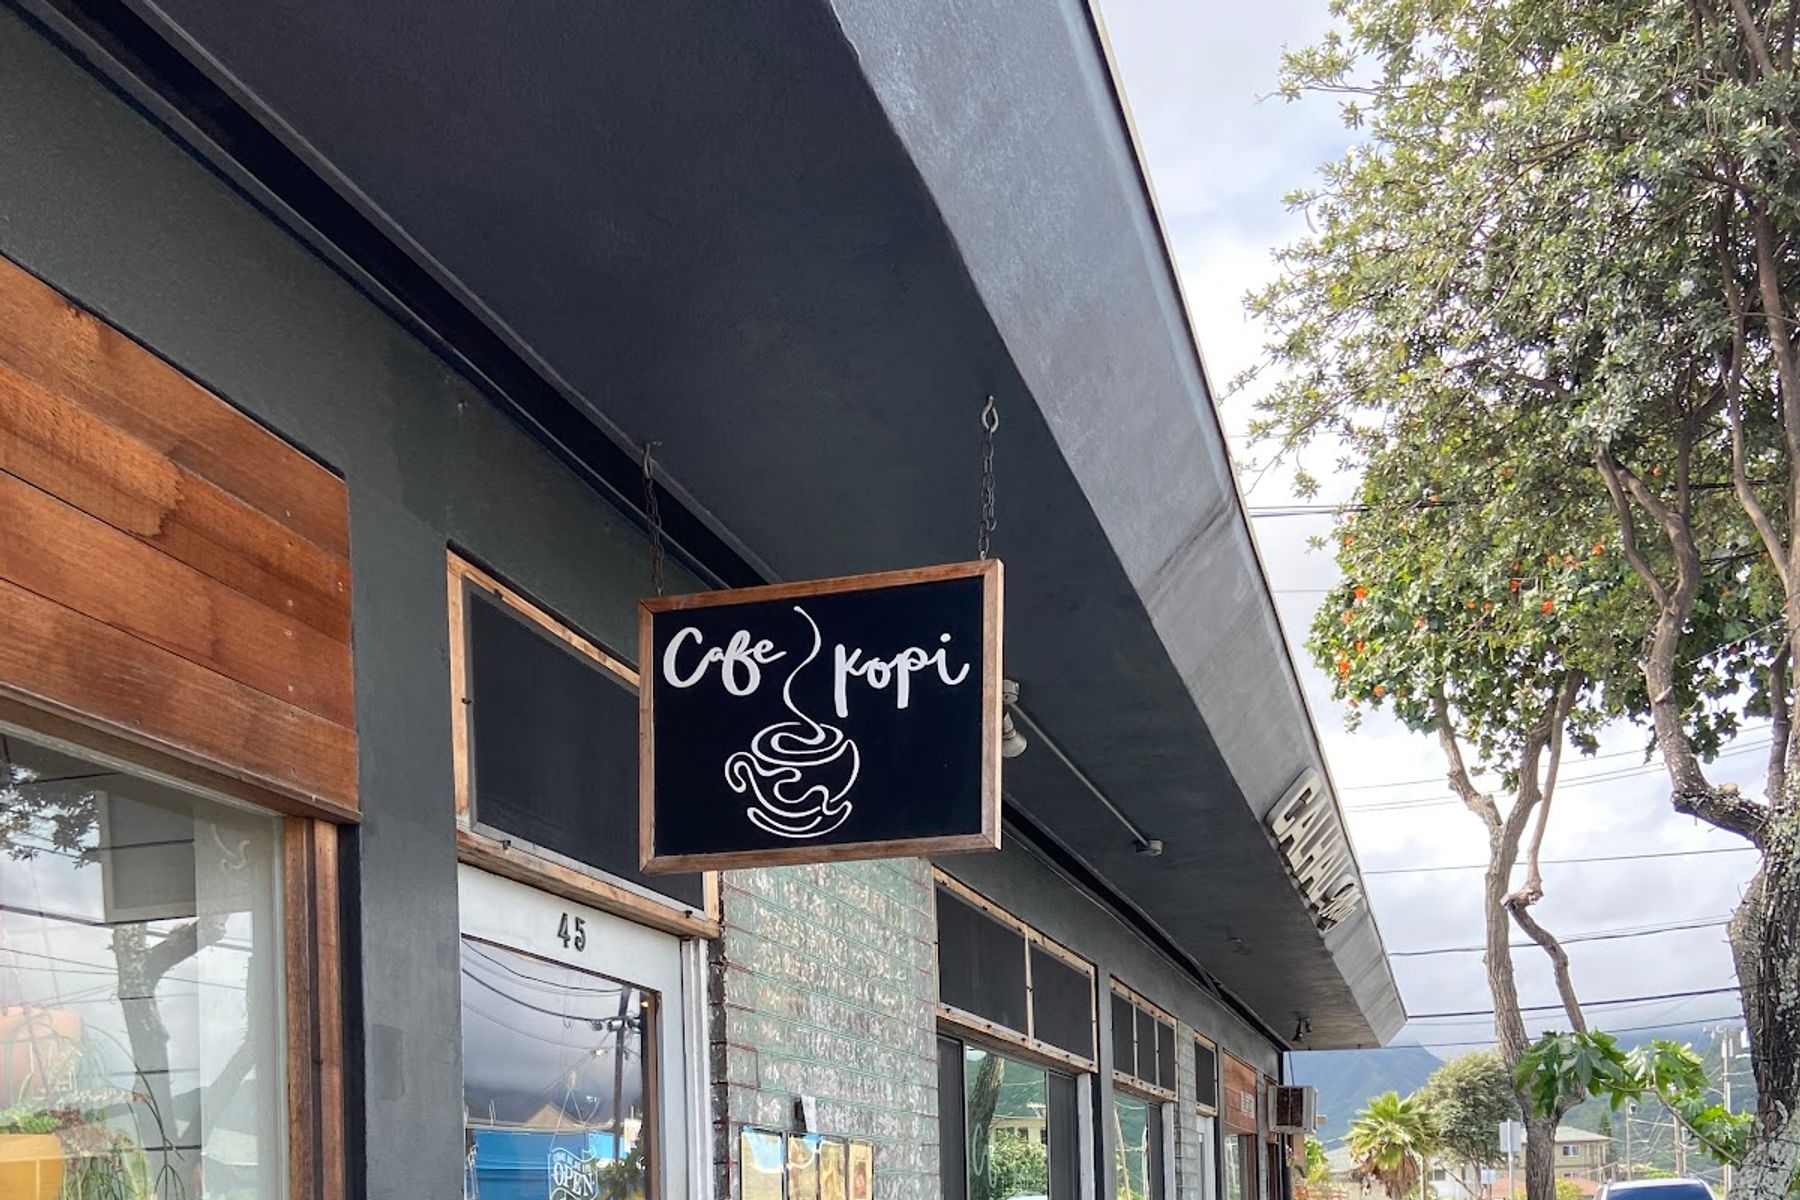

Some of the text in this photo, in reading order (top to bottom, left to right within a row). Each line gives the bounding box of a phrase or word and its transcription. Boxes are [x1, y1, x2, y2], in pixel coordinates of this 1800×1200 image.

[662, 626, 788, 697] Cafe
[556, 911, 587, 953] 45
[552, 1161, 595, 1198] OPEN
